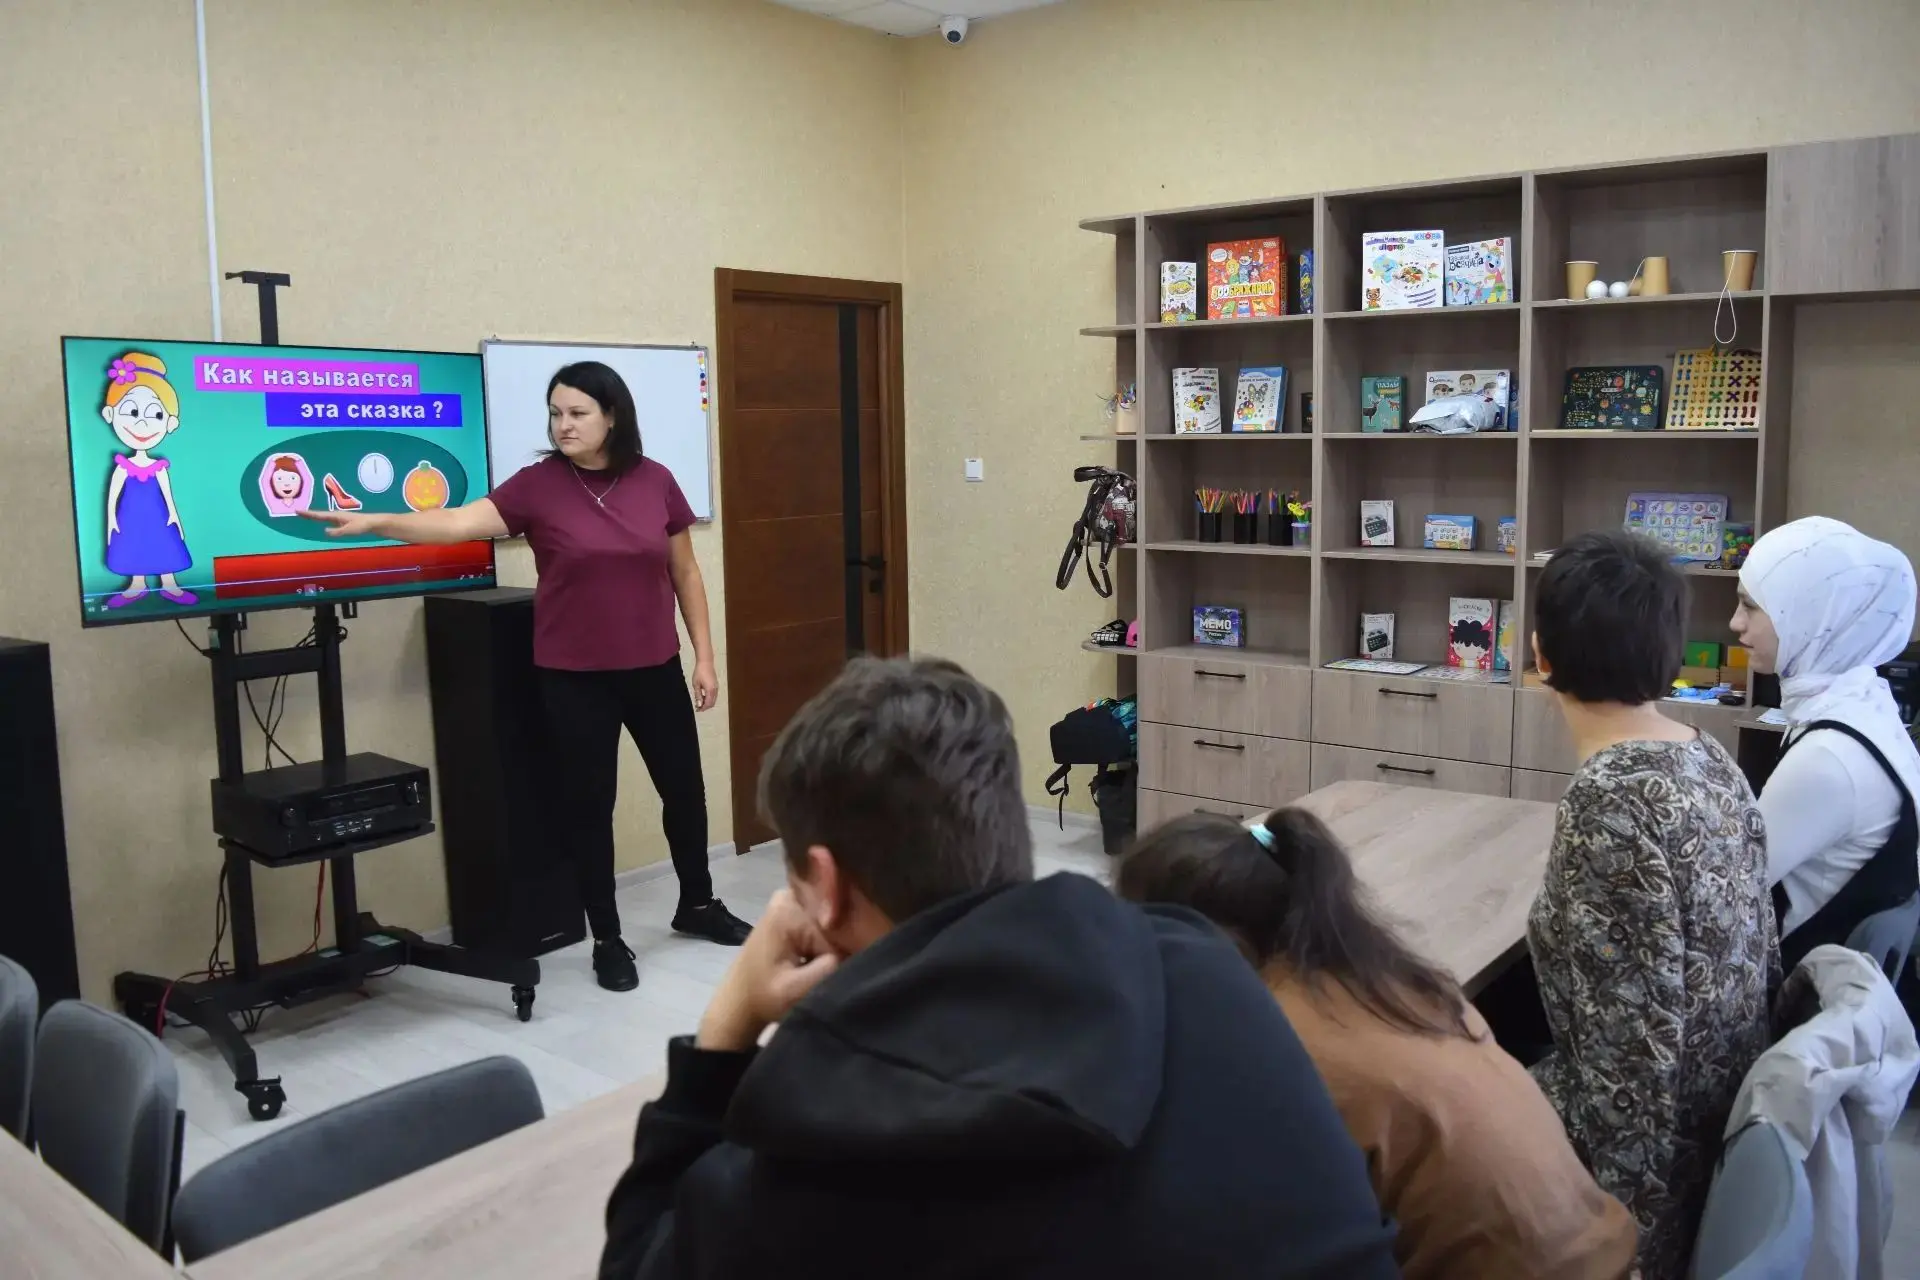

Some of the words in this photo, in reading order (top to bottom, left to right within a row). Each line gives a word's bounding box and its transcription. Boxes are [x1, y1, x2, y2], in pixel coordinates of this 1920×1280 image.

[203, 362, 254, 385] Как
[263, 369, 413, 388] называется
[300, 402, 339, 418] эта
[347, 402, 425, 419] сказка
[432, 400, 443, 419] ?
